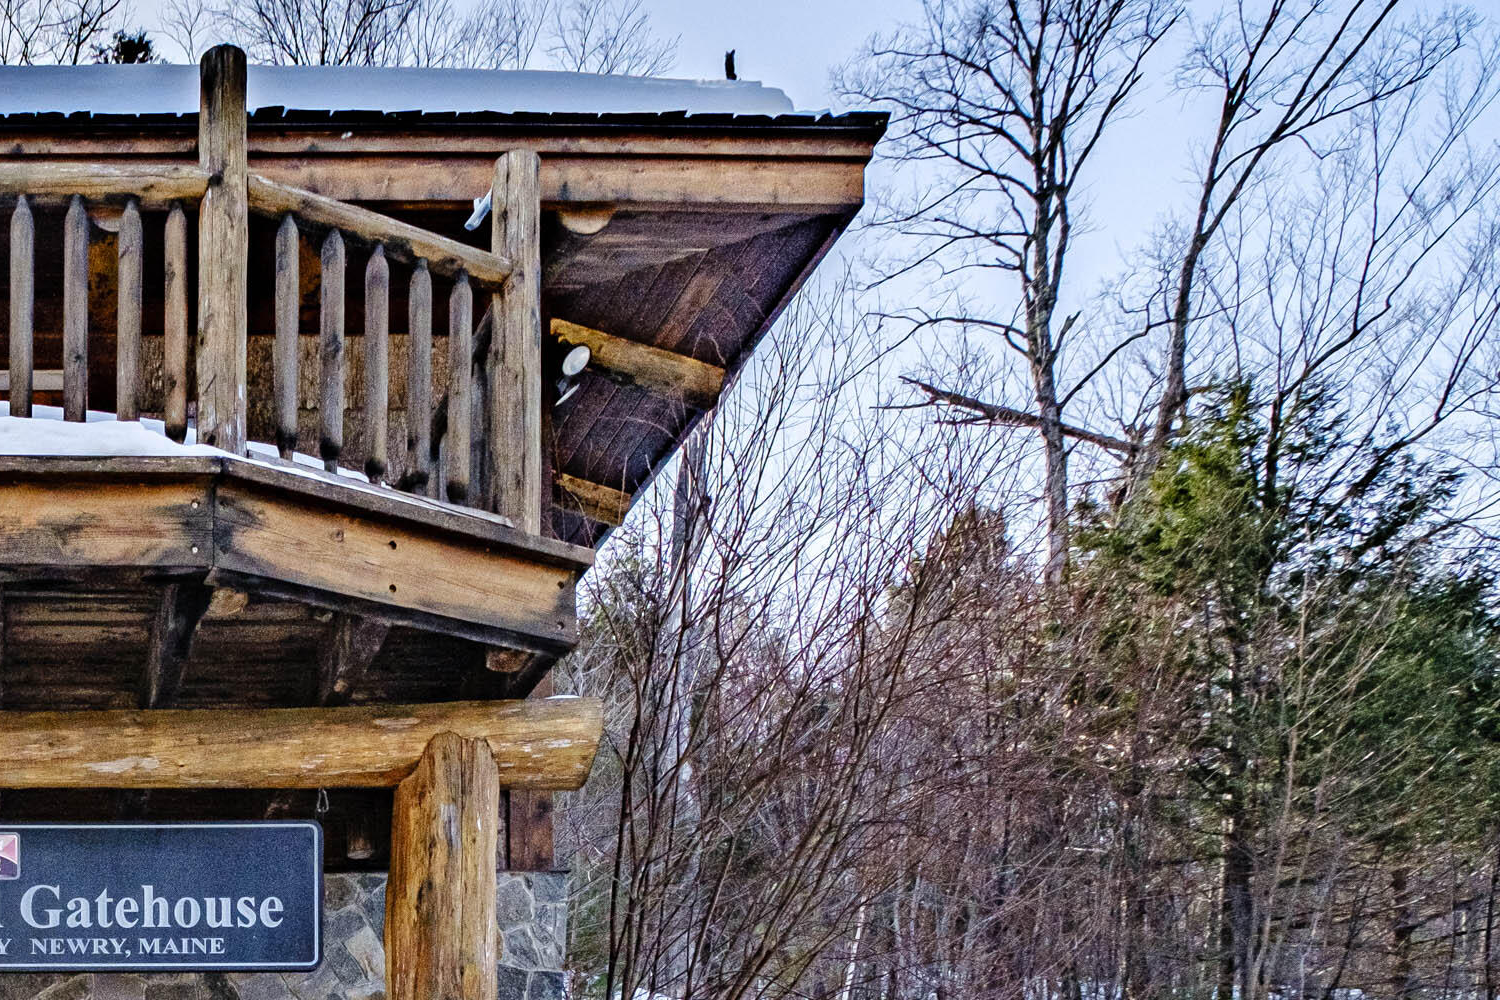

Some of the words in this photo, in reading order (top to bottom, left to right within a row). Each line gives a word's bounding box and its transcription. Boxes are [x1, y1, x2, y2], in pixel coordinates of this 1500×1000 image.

[19, 884, 284, 930] Gatehouse
[30, 938, 131, 959] NEWRY,
[138, 937, 226, 955] MAINE
